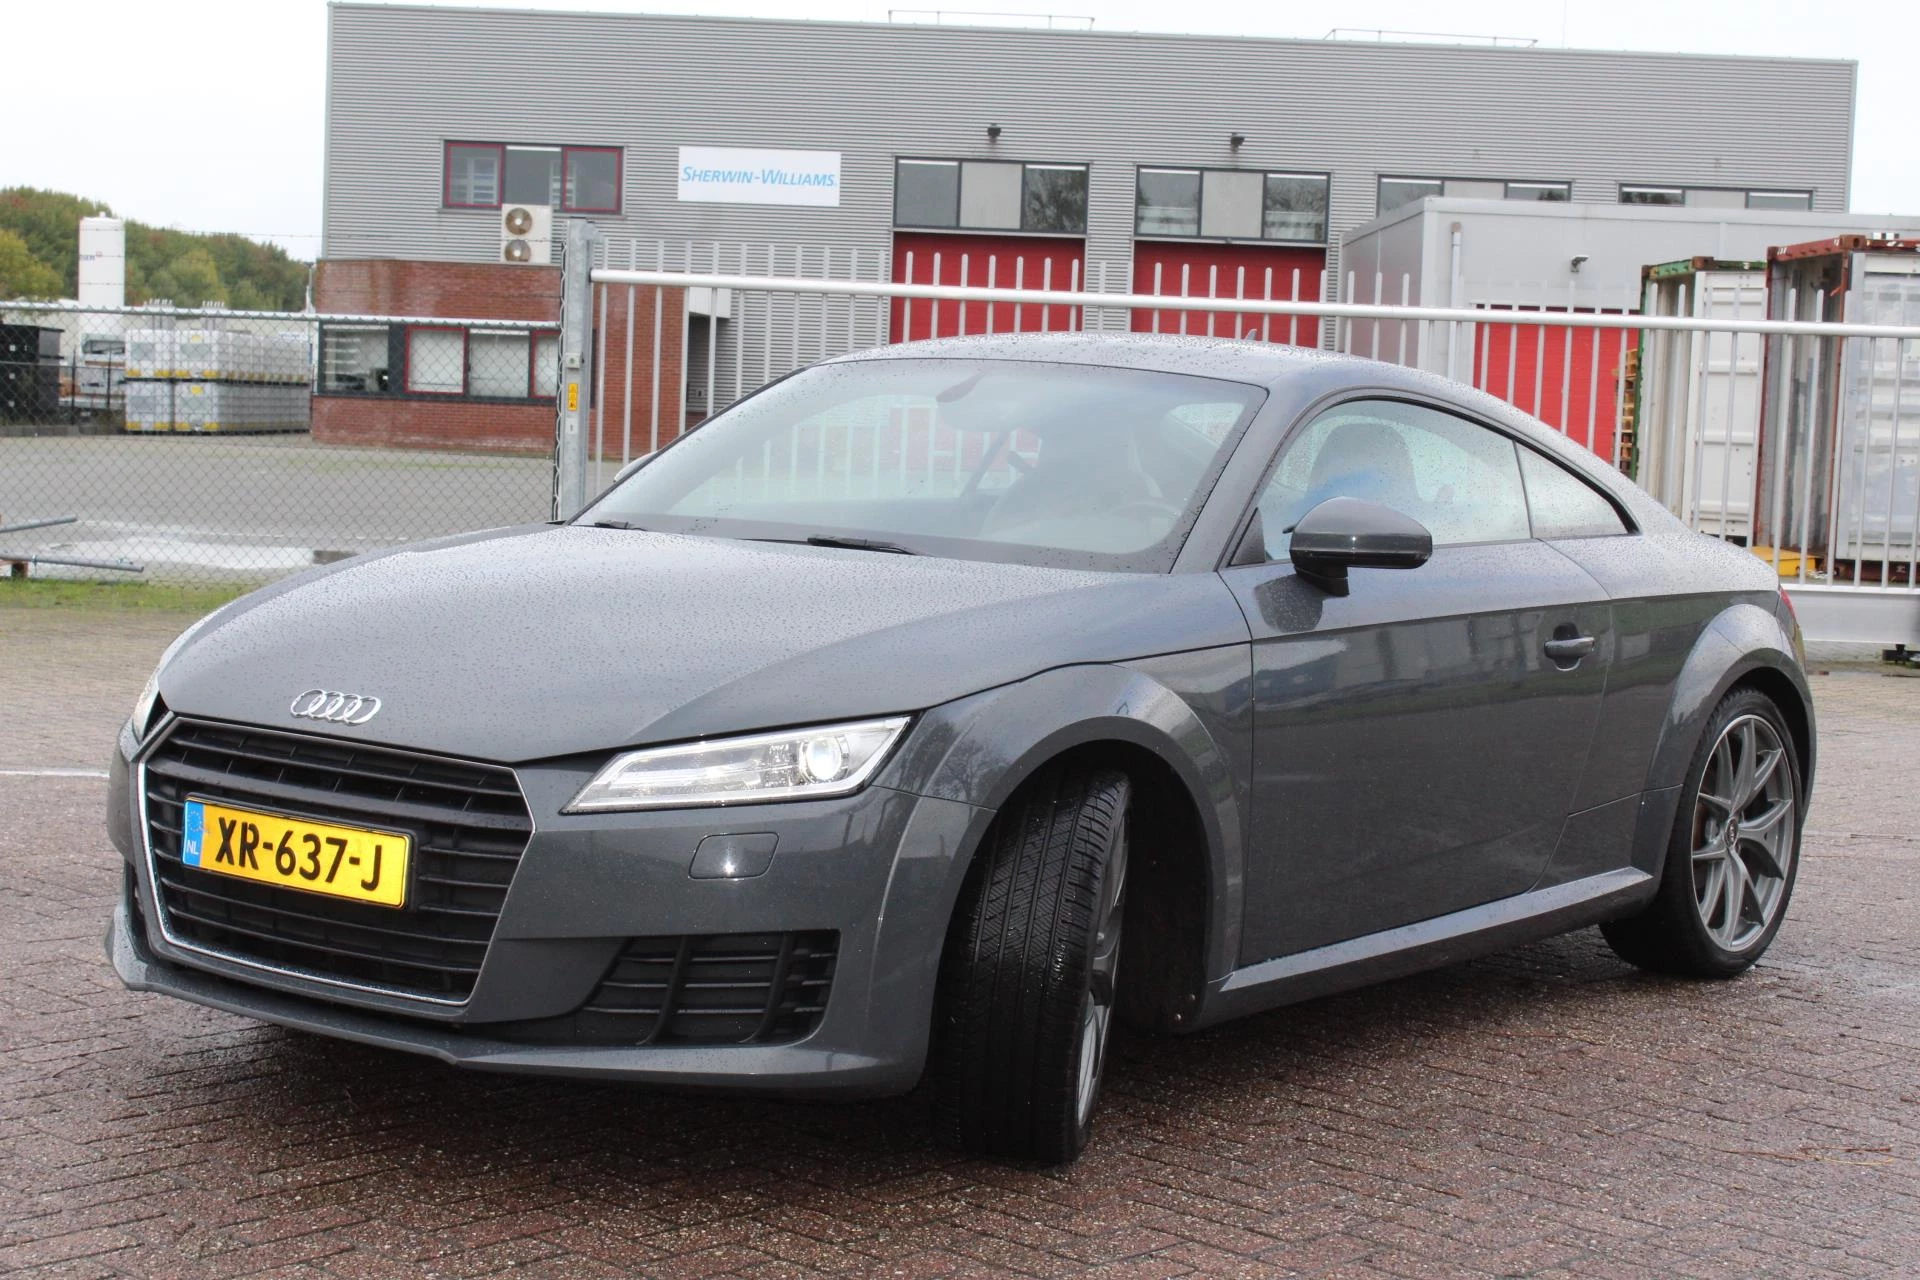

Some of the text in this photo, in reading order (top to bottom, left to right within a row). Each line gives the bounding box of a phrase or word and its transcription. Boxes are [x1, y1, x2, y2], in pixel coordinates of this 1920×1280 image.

[681, 165, 835, 187] SHERWIN-WILLIAMS
[186, 839, 200, 856] NL
[215, 816, 382, 891] XR-637-J
